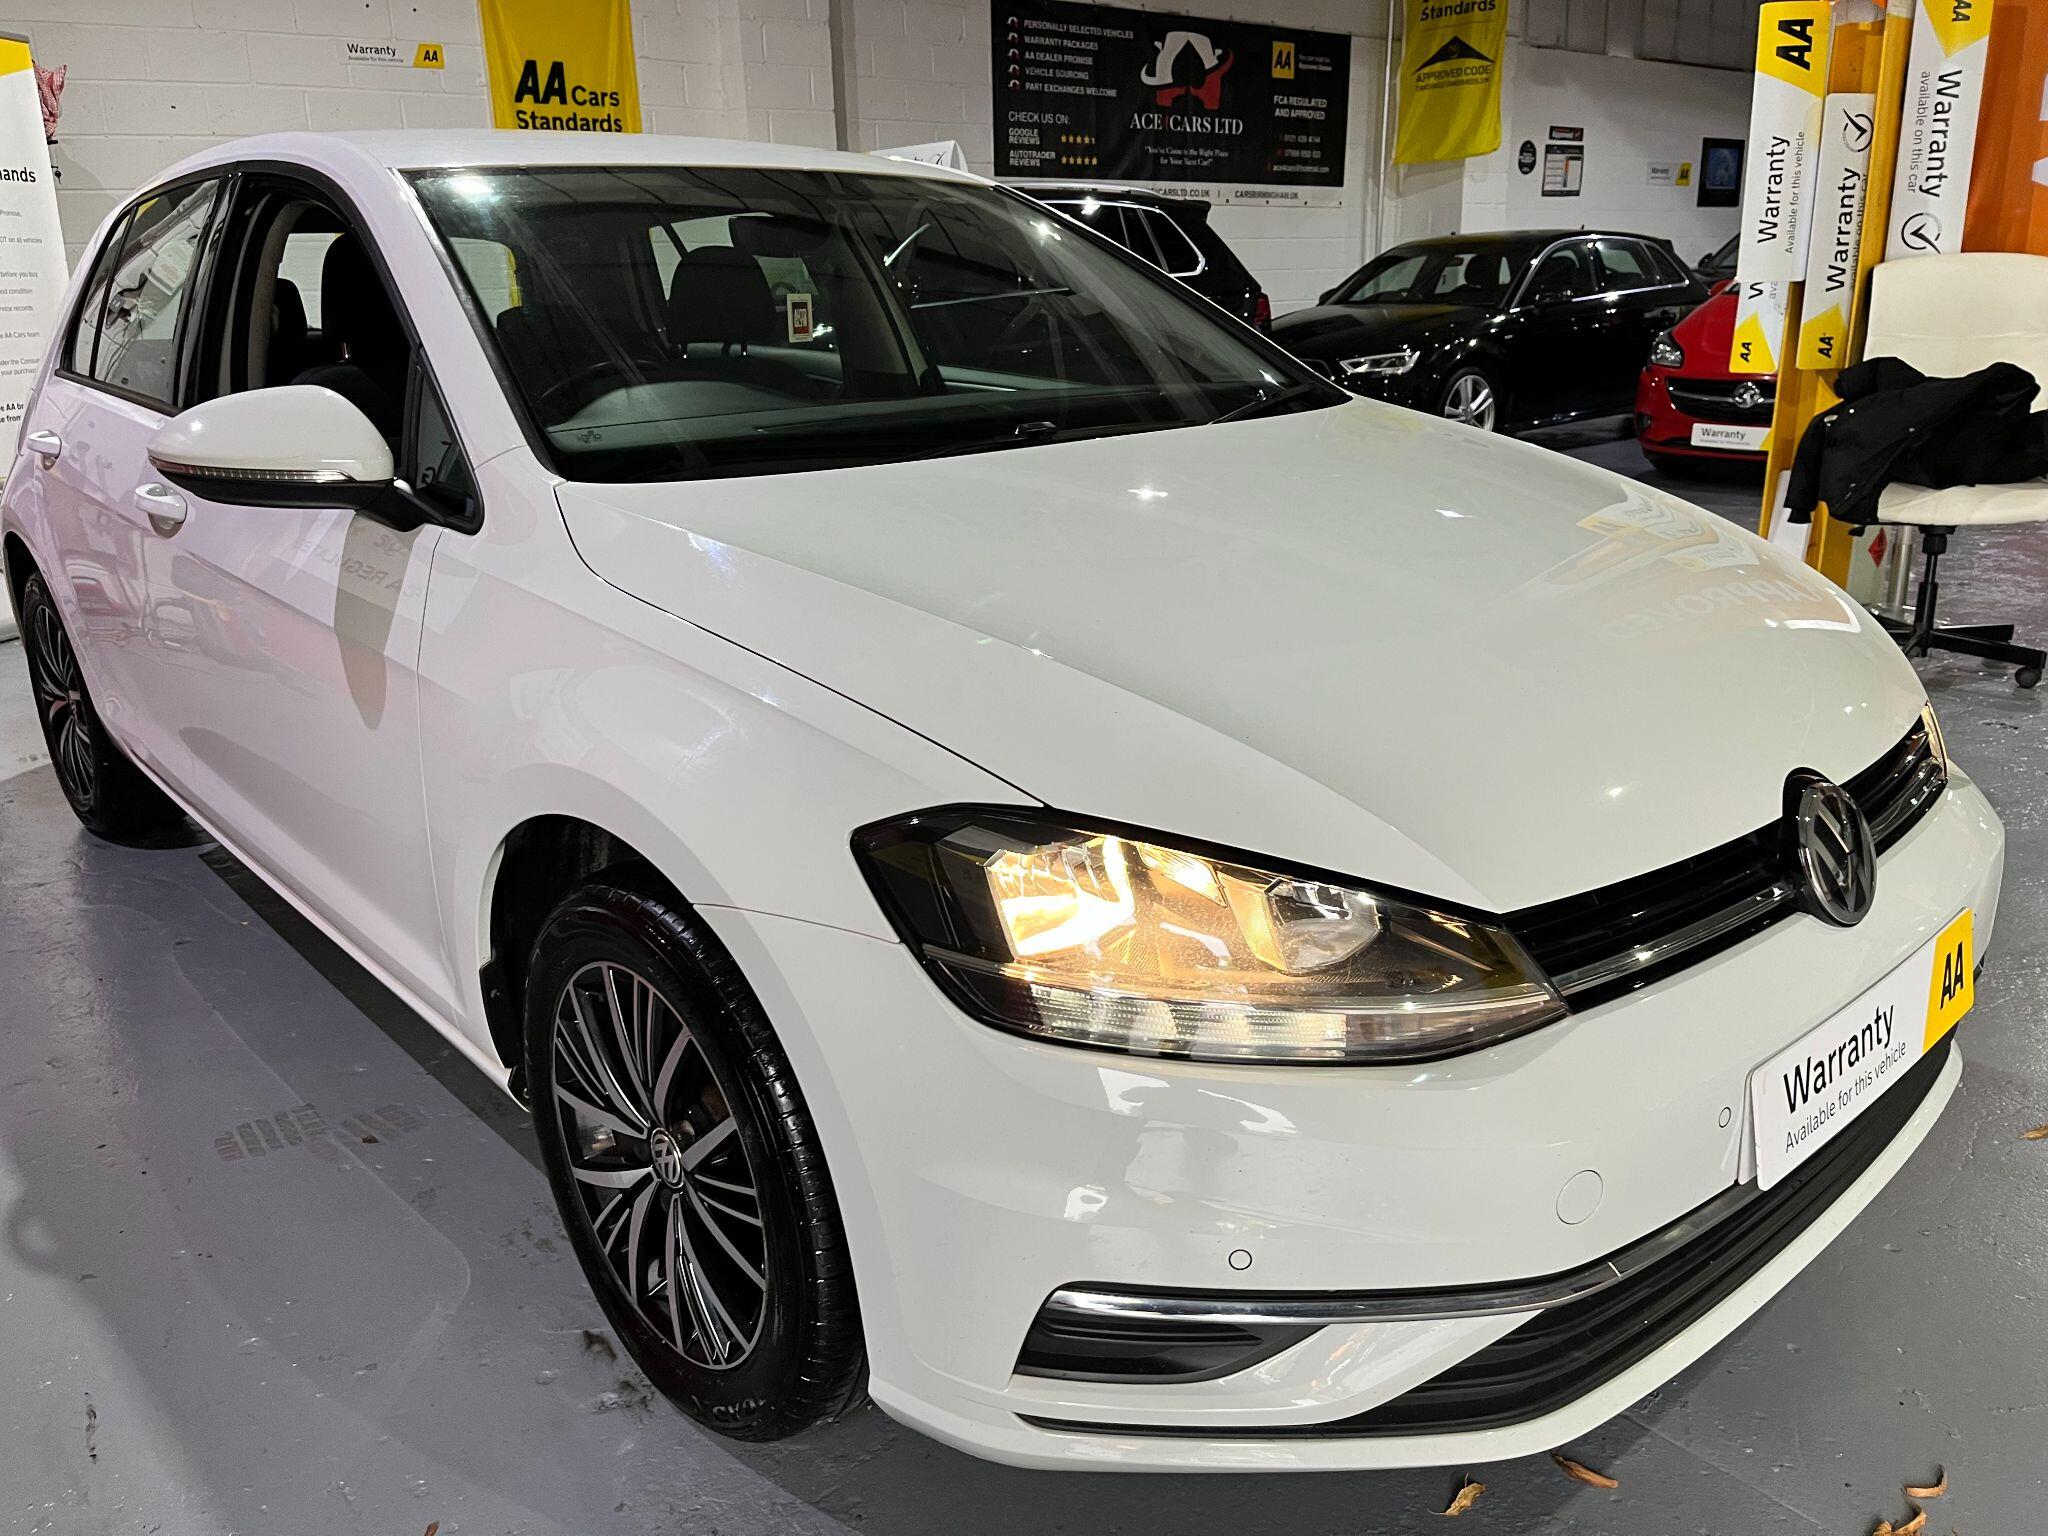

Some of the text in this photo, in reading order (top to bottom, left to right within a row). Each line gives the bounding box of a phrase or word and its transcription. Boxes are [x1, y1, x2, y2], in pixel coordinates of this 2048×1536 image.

[1420, 0, 1496, 21] Standards
[1952, 0, 1973, 22] AA
[1023, 19, 1134, 39] PERSONALLY SELECTED VEHICLES
[346, 42, 439, 62] Warranty AA
[1023, 35, 1099, 51] WARRANTY PACKAGES
[1776, 18, 1815, 71] AA
[1024, 51, 1094, 65] AA DEALER PROMISE
[1273, 49, 1291, 70] AA
[514, 59, 620, 107] AA Cars
[1025, 67, 1089, 80] VEHICLE SOURCING
[1416, 65, 1492, 83] APPROVED CODE
[1025, 82, 1117, 97] PART EXCHANGES WELCOME
[1273, 95, 1328, 108] FCA REGULATED
[516, 109, 623, 132] Standards
[1008, 111, 1040, 123] CHECK
[1041, 113, 1054, 124] US
[1274, 108, 1326, 120] AND APPROVED
[1008, 127, 1039, 137] GOOGLE
[1214, 117, 1243, 135] LTD
[1907, 71, 1931, 193] available on this car
[1920, 69, 1963, 198] Warranty
[1008, 136, 1041, 145] REVIEWS
[1009, 150, 1056, 159] AUTOTRADER
[1009, 158, 1041, 167] REVIEWS
[1757, 136, 1790, 244] Warranty
[1784, 131, 1805, 254] Available for this vehicle
[1825, 168, 1860, 292] Warranty
[1740, 341, 1752, 363] AA
[1817, 335, 1834, 359] AA
[6, 403, 16, 411] AA
[1701, 427, 1746, 441] Warranty
[1782, 941, 1965, 1115] Warranty AA
[1785, 1040, 1907, 1154] Available for this vehicle
